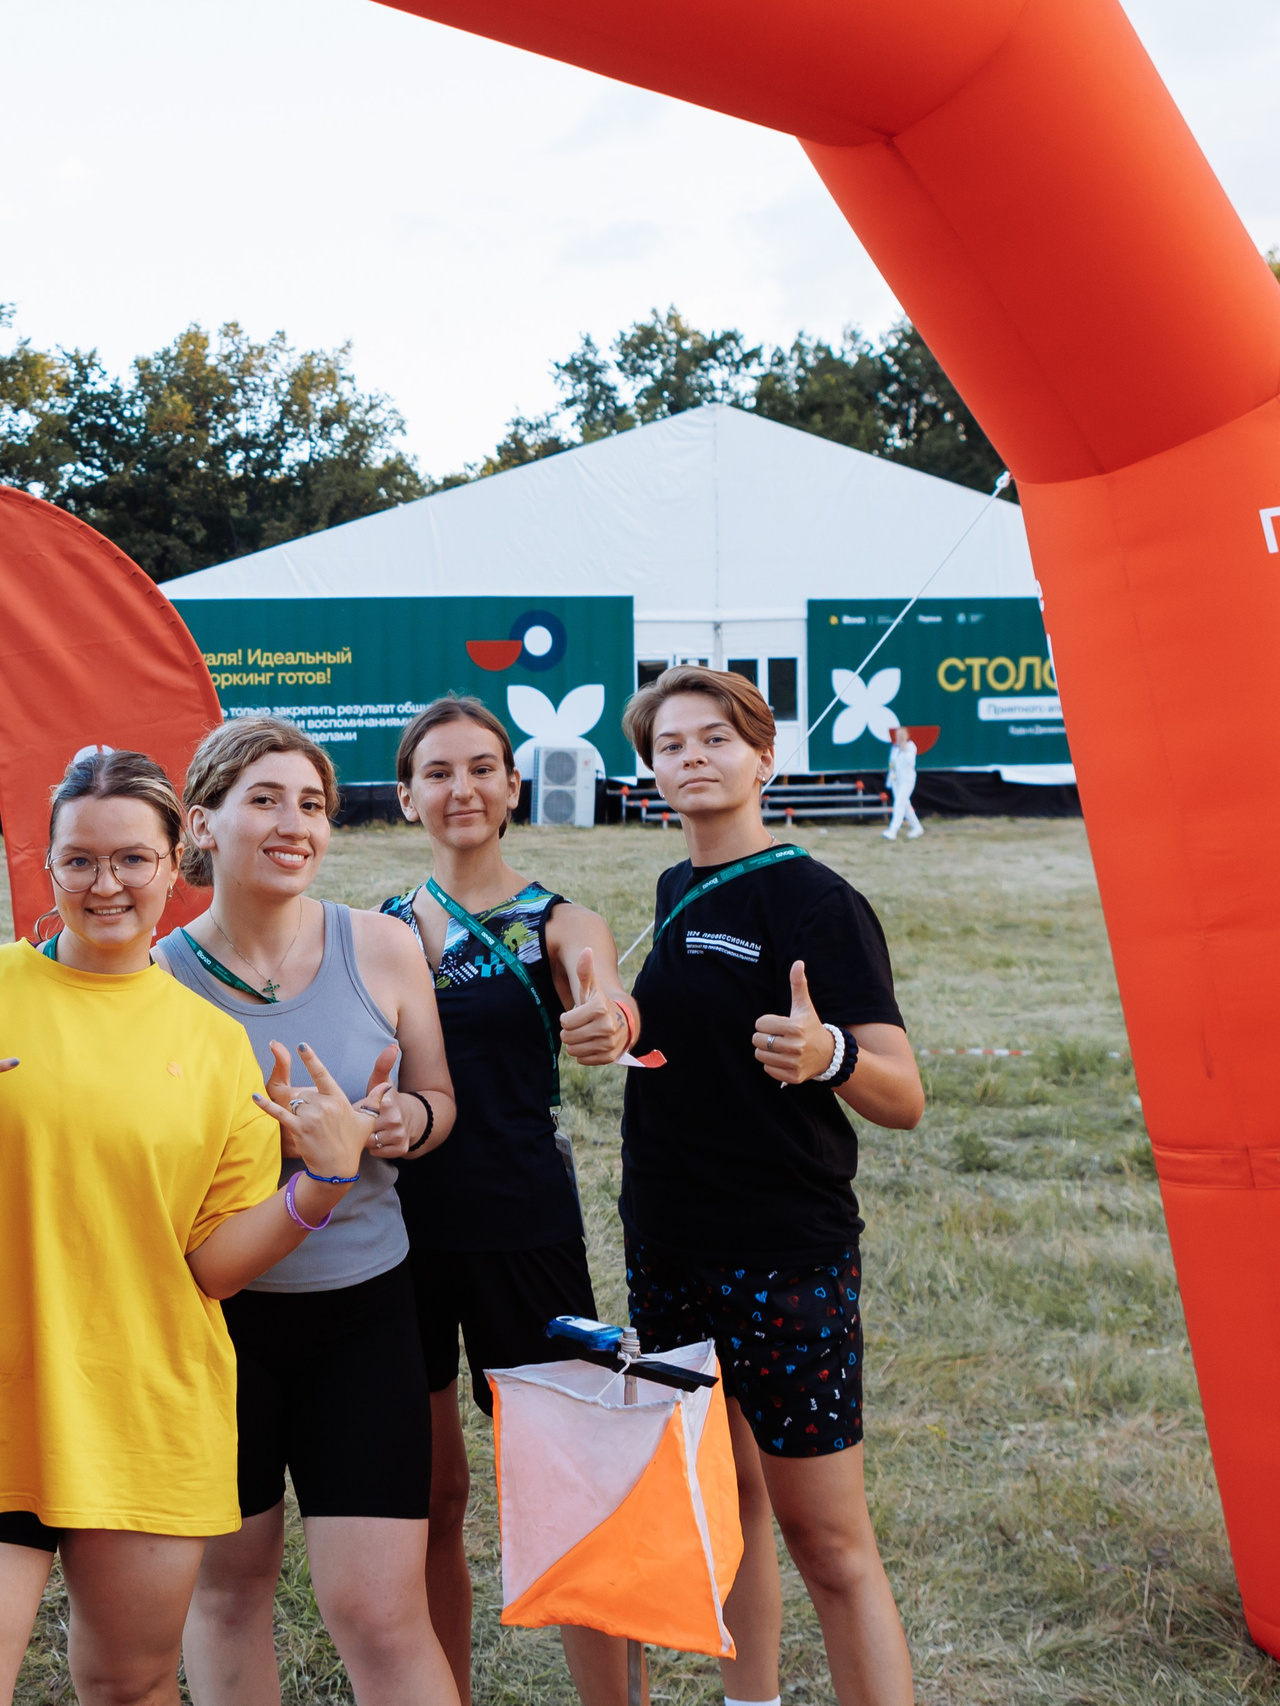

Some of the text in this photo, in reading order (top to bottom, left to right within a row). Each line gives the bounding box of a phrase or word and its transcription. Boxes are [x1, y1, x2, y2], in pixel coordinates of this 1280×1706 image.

[202, 646, 352, 668] аля! Идеальный
[210, 667, 331, 690] оркинг готов!
[229, 706, 271, 716] только
[272, 705, 335, 718] закрепить
[337, 703, 395, 717] результат
[702, 932, 762, 951] ПРОФЕССИОНАЛЫ
